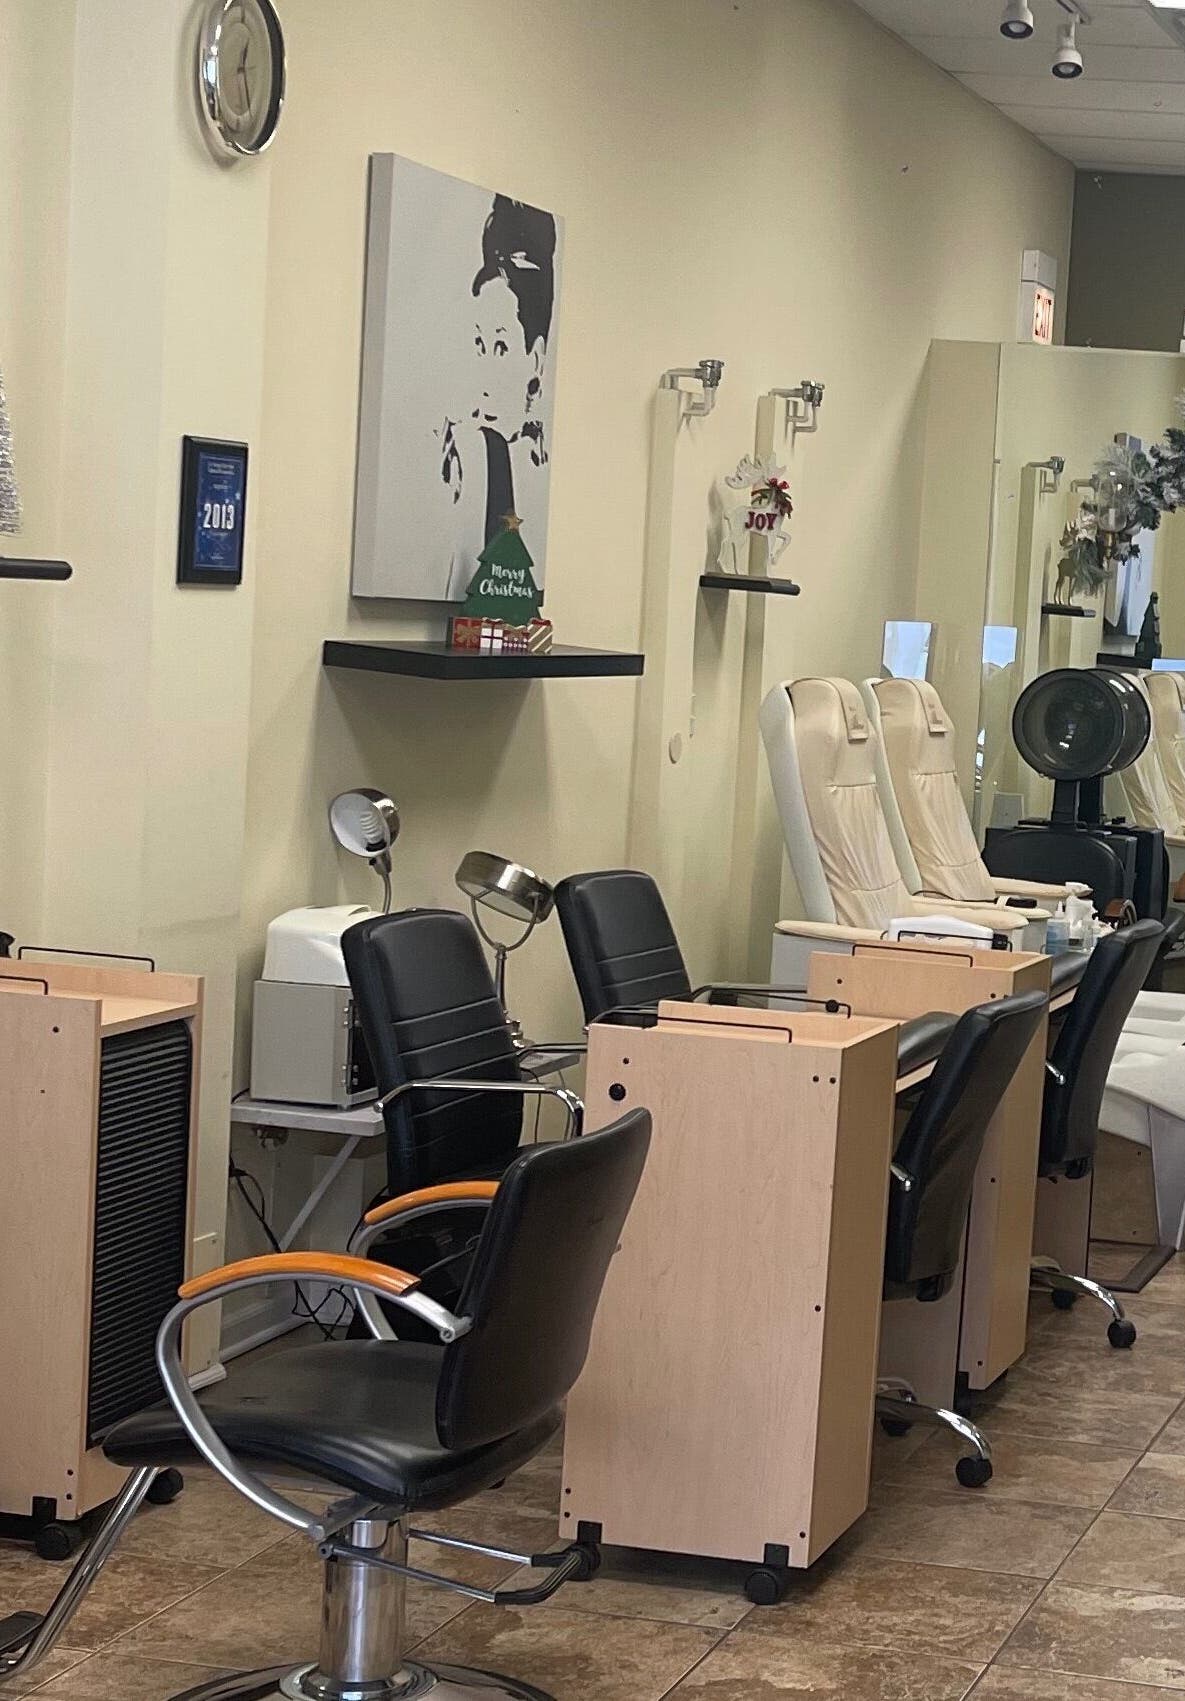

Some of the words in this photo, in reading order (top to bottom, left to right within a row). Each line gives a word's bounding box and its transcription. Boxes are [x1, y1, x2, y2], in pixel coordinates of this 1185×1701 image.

[203, 503, 235, 530] 2013
[745, 511, 778, 531] JOY
[491, 563, 525, 584] Merry
[479, 578, 533, 599] Christmas
